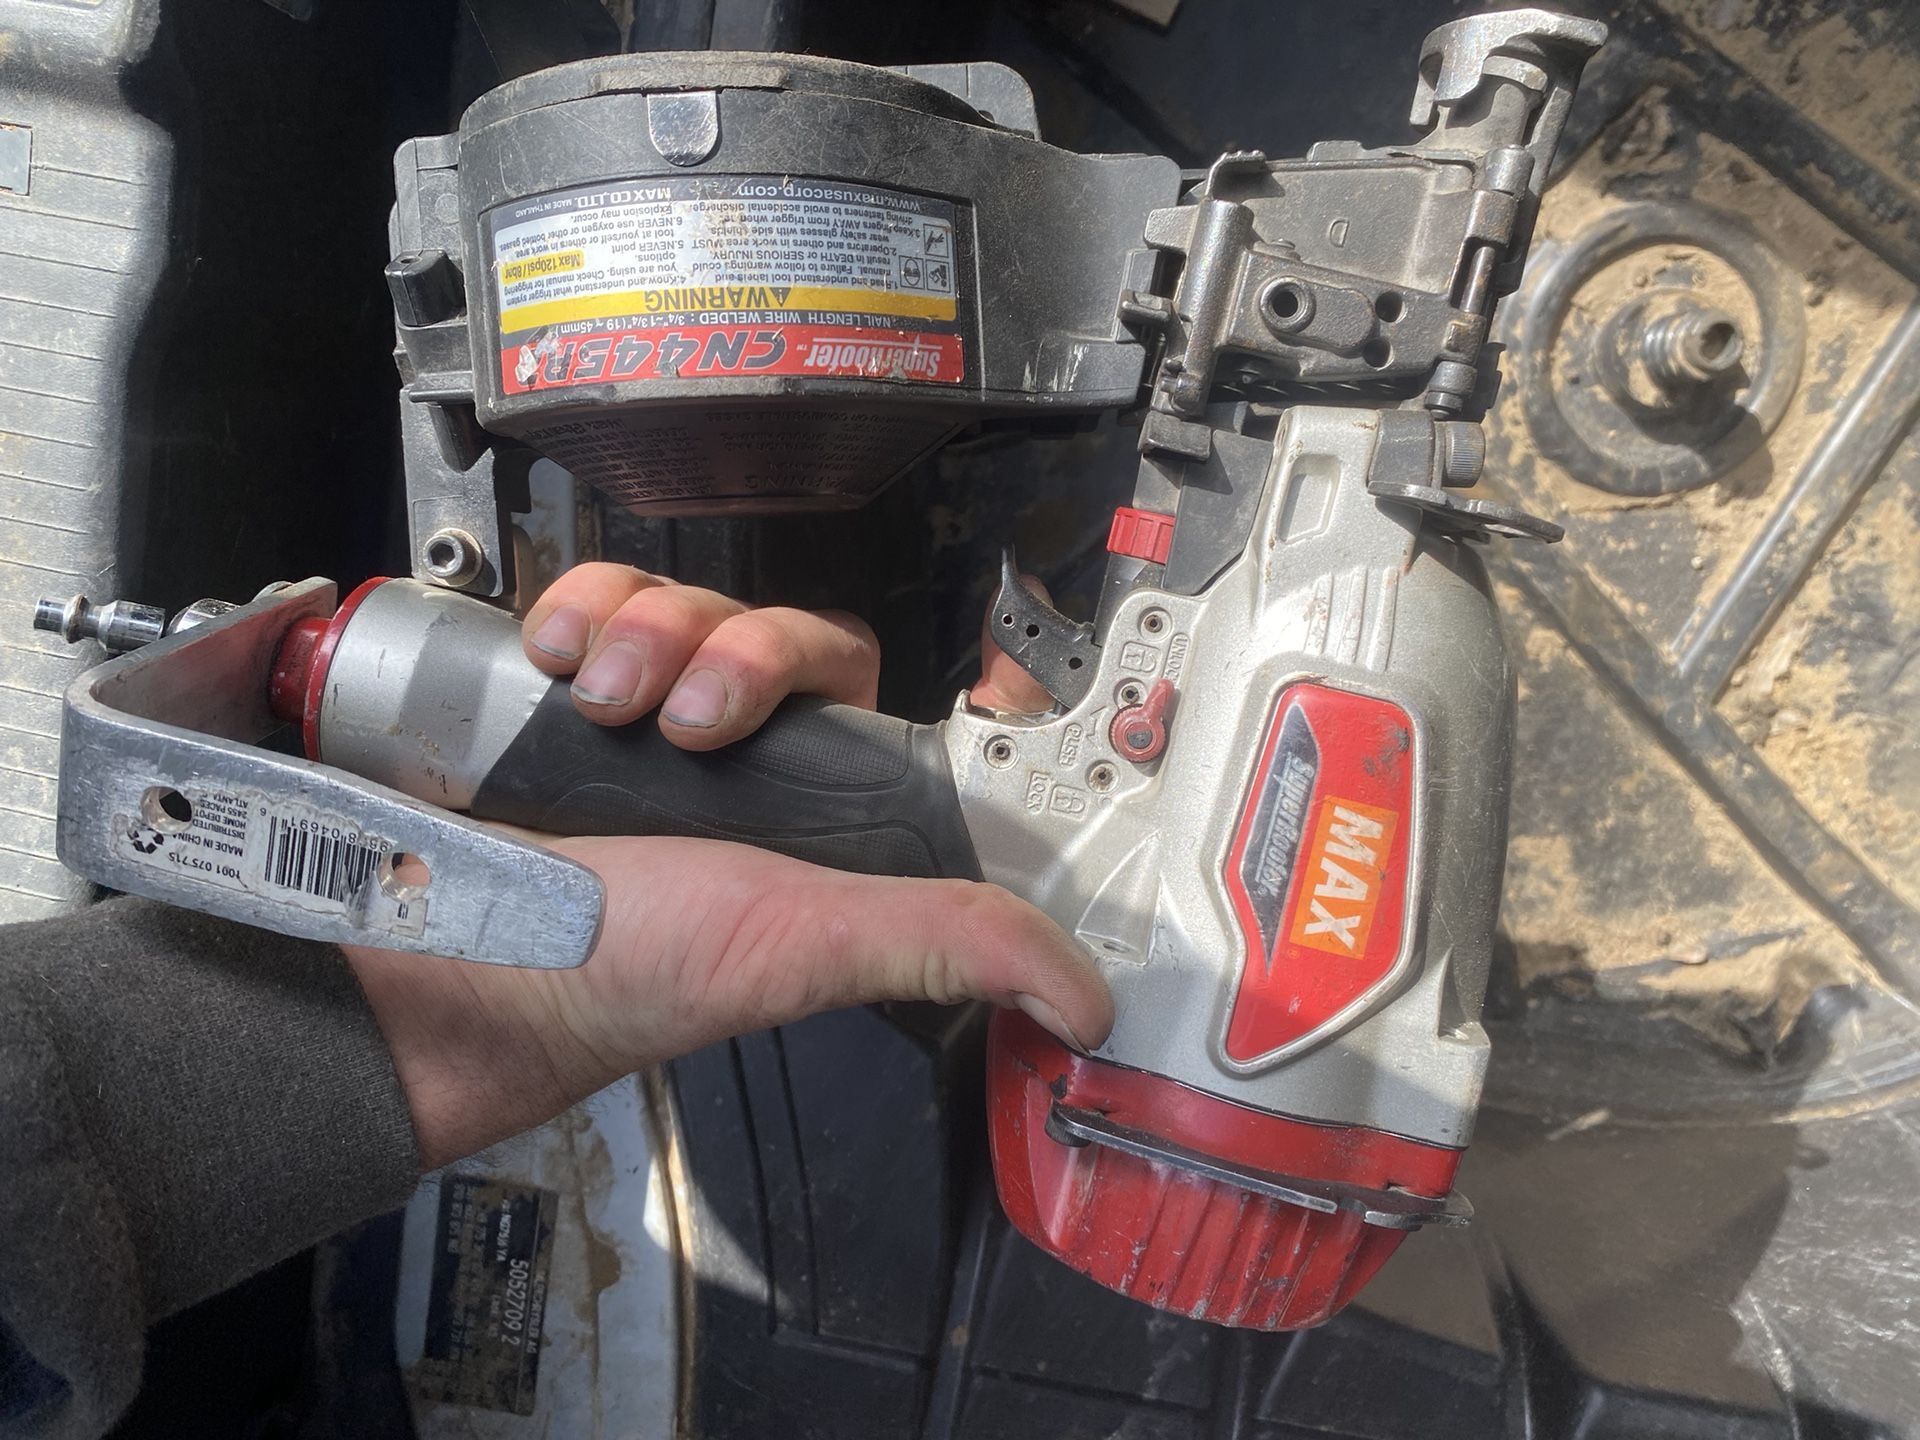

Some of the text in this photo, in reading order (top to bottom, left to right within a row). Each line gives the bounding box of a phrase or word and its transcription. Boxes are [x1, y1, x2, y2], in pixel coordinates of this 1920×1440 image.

[632, 187, 671, 203] MAX
[737, 184, 920, 211] www.maxusacorp.com
[515, 199, 572, 218] MADE IN THAILAND
[570, 204, 672, 223] Explosion may occur.
[748, 203, 800, 213] accidental
[803, 204, 830, 214] avoid
[832, 207, 842, 216] to
[844, 207, 884, 221] fasteners
[637, 216, 683, 228] 6.NEVER
[740, 214, 768, 224] when
[770, 213, 805, 225] trigger
[807, 216, 830, 226] from
[832, 219, 860, 229] AWAY
[886, 211, 912, 225] driving
[581, 221, 614, 233] oxygen
[617, 220, 634, 229] use
[547, 228, 568, 240] other
[570, 227, 580, 235] or
[600, 229, 640, 245] yourself
[642, 230, 652, 239] at
[654, 229, 674, 238] tool
[751, 227, 774, 236] side
[776, 227, 798, 236] with
[800, 227, 838, 238] glasses
[840, 230, 867, 241] safety
[521, 233, 546, 247] bottled
[560, 237, 587, 249] others
[589, 236, 599, 244] or
[725, 238, 750, 247] area
[752, 239, 778, 248] work
[780, 239, 790, 248] in
[869, 233, 890, 242] wear
[531, 244, 550, 255] work
[550, 241, 559, 252] in
[611, 240, 684, 254] 5.NEVER point
[792, 240, 824, 249] others
[827, 241, 844, 250] and
[846, 243, 897, 256] 2.Operators
[558, 253, 580, 268] Max
[634, 251, 676, 262] options.
[709, 250, 890, 265] result in DEATH or SERIOUS INJURY.
[692, 260, 891, 276] manual. Failure to follow warnings could
[503, 262, 678, 296] you are using. Check manual for triggering
[627, 277, 646, 288] and
[715, 273, 735, 283] and
[736, 273, 769, 283] labels
[771, 273, 791, 283] tool
[794, 274, 849, 285] understand
[851, 276, 868, 286] and
[553, 286, 572, 297] what
[574, 280, 625, 294] understand
[506, 293, 527, 307] system
[528, 289, 552, 301] trigger
[644, 287, 770, 311] WARNING
[699, 311, 761, 325] WELDED
[765, 311, 801, 324] WIRE
[807, 311, 861, 325] LENGTH
[863, 313, 891, 328] NAIL
[1061, 727, 1082, 767] PUSH
[1026, 775, 1048, 809] LOCK
[199, 799, 248, 820] 2455 PACES
[259, 807, 267, 817] 6
[194, 809, 246, 829] HOME DEPOT
[192, 818, 245, 840] DISTRIBUTED
[291, 816, 340, 840] 04691
[203, 837, 214, 849] IN
[215, 841, 244, 857] MADE
[168, 851, 241, 880] 1001 075 715
[1304, 805, 1384, 950] MAX
[500, 1258, 530, 1345] 5052709 2
